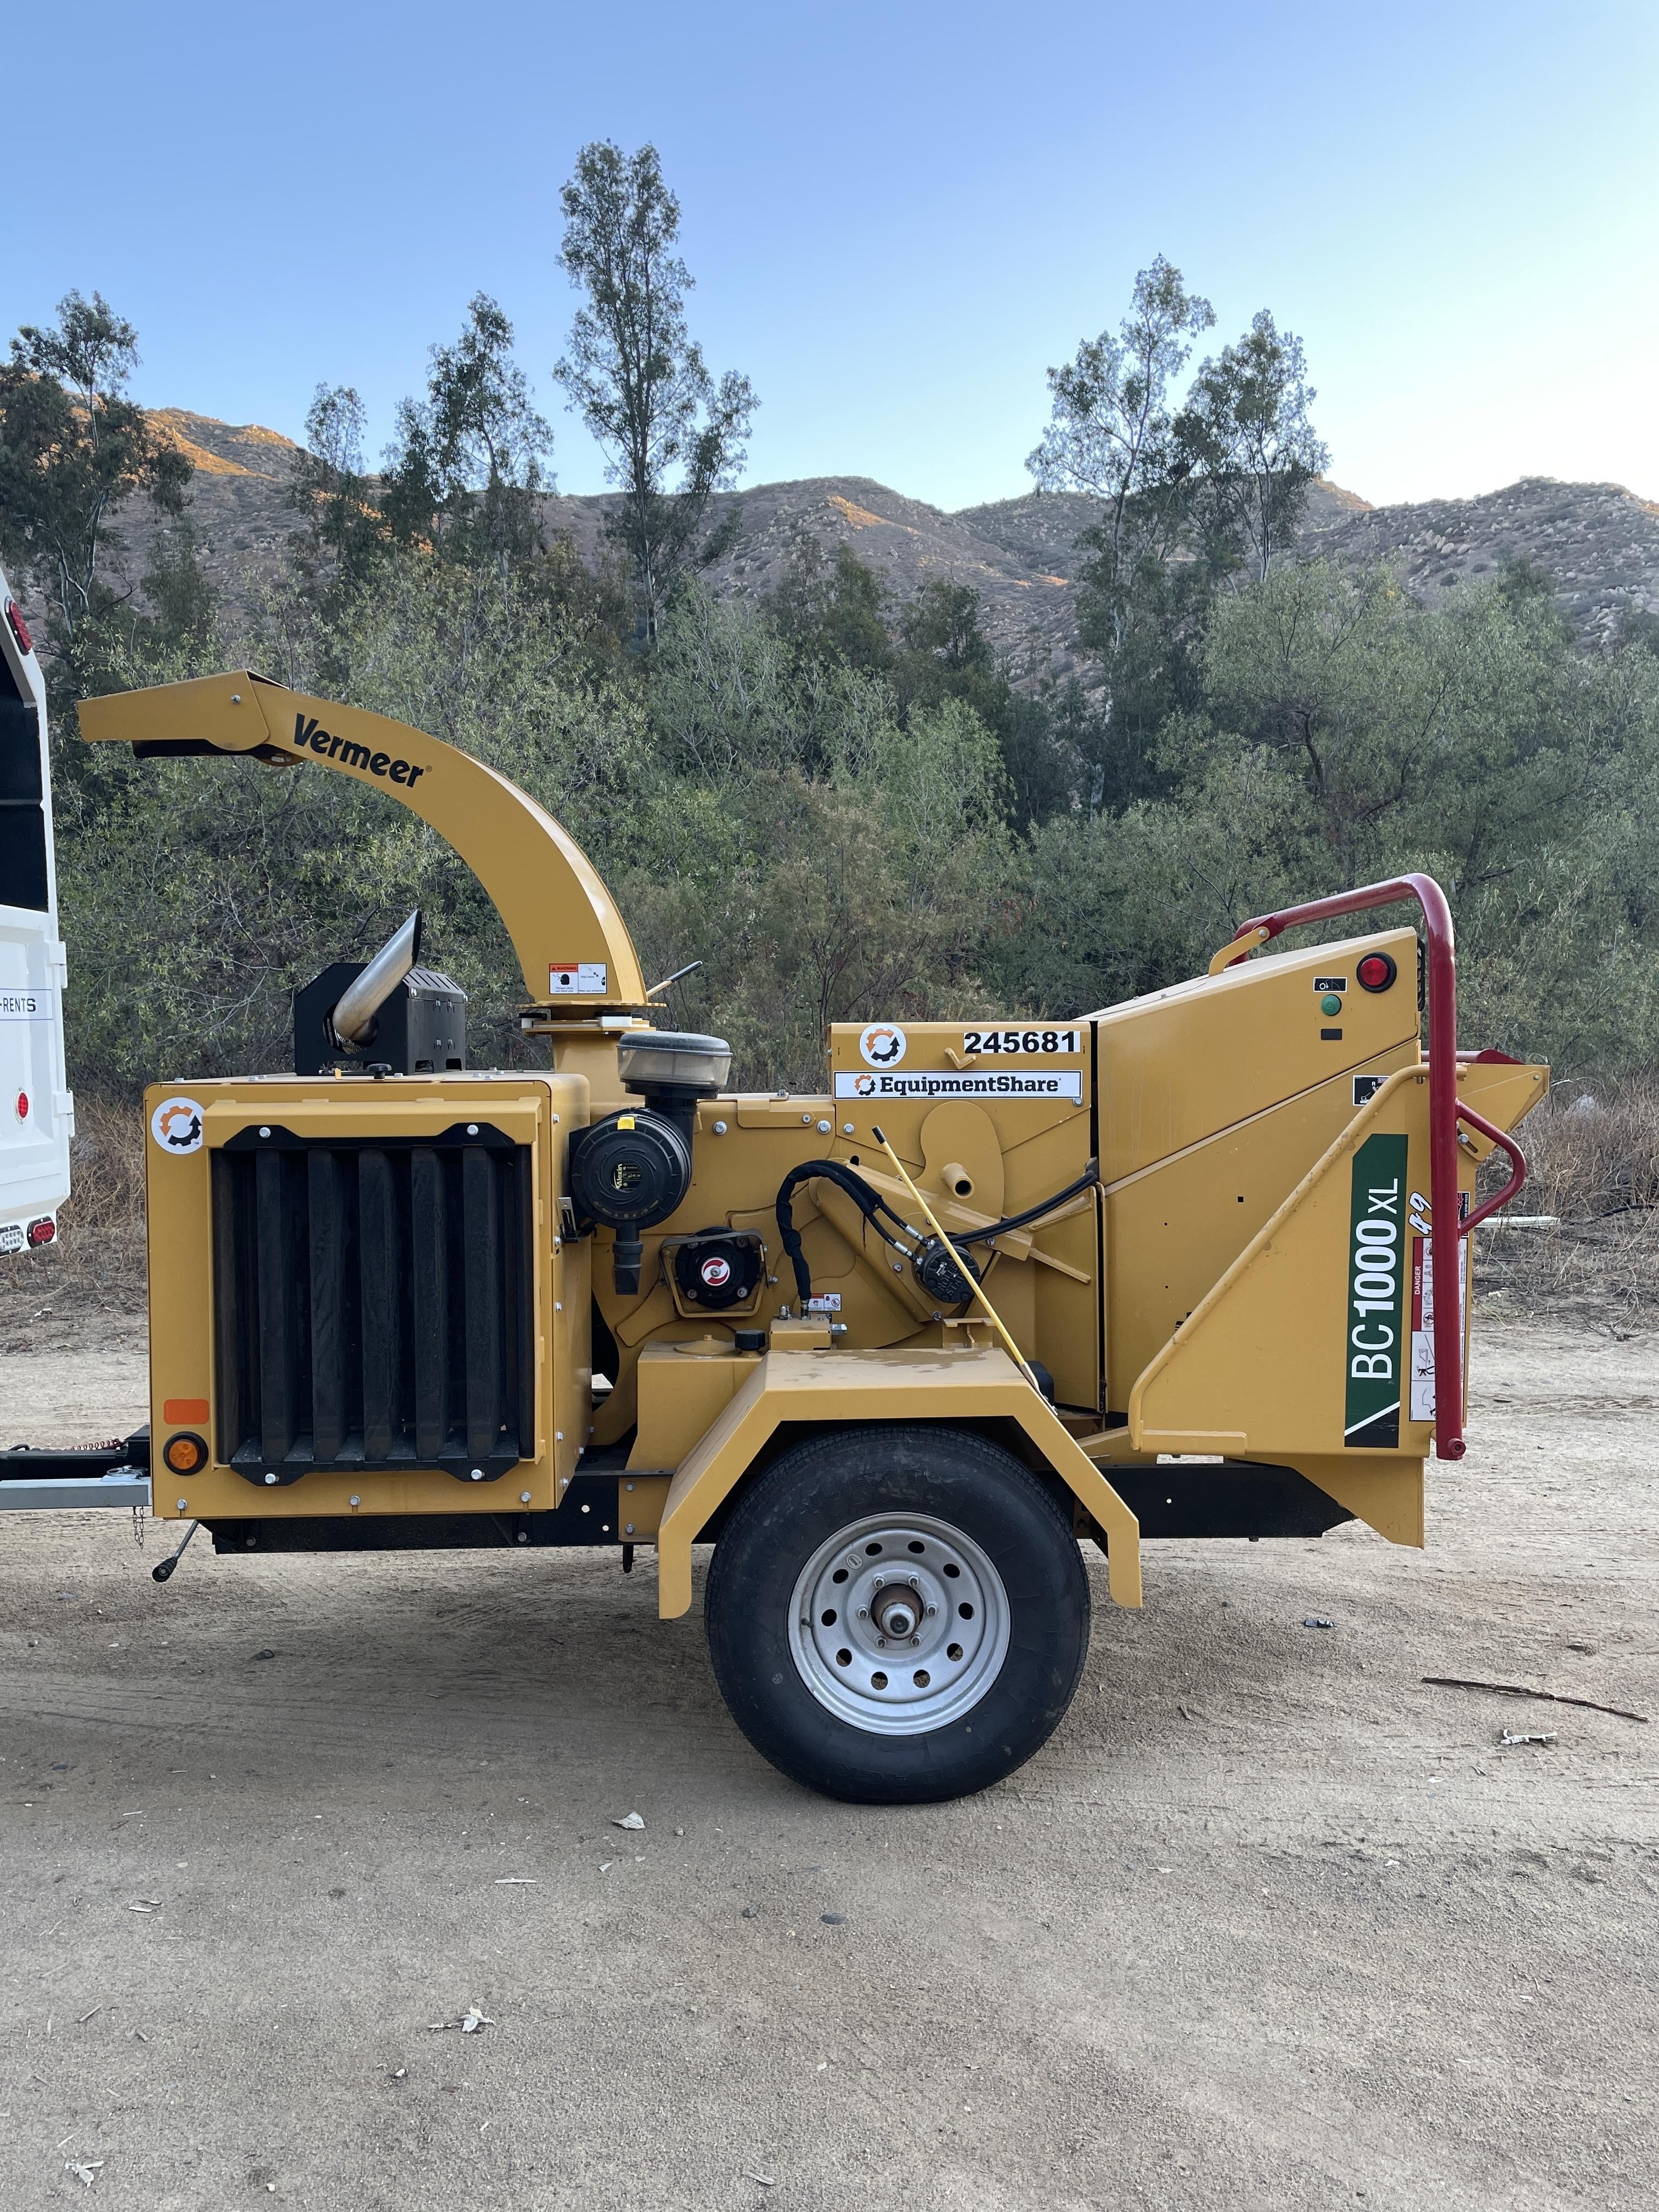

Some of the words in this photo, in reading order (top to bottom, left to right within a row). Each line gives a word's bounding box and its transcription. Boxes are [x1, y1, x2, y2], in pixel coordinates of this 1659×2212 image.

[294, 713, 424, 788] Vermeer
[964, 1031, 1074, 1053] 245681
[879, 1076, 1058, 1096] EquipmentShare
[1368, 1178, 1398, 1215] XL
[1408, 1191, 1432, 1235] 49
[1351, 1219, 1397, 1379] BC1000
